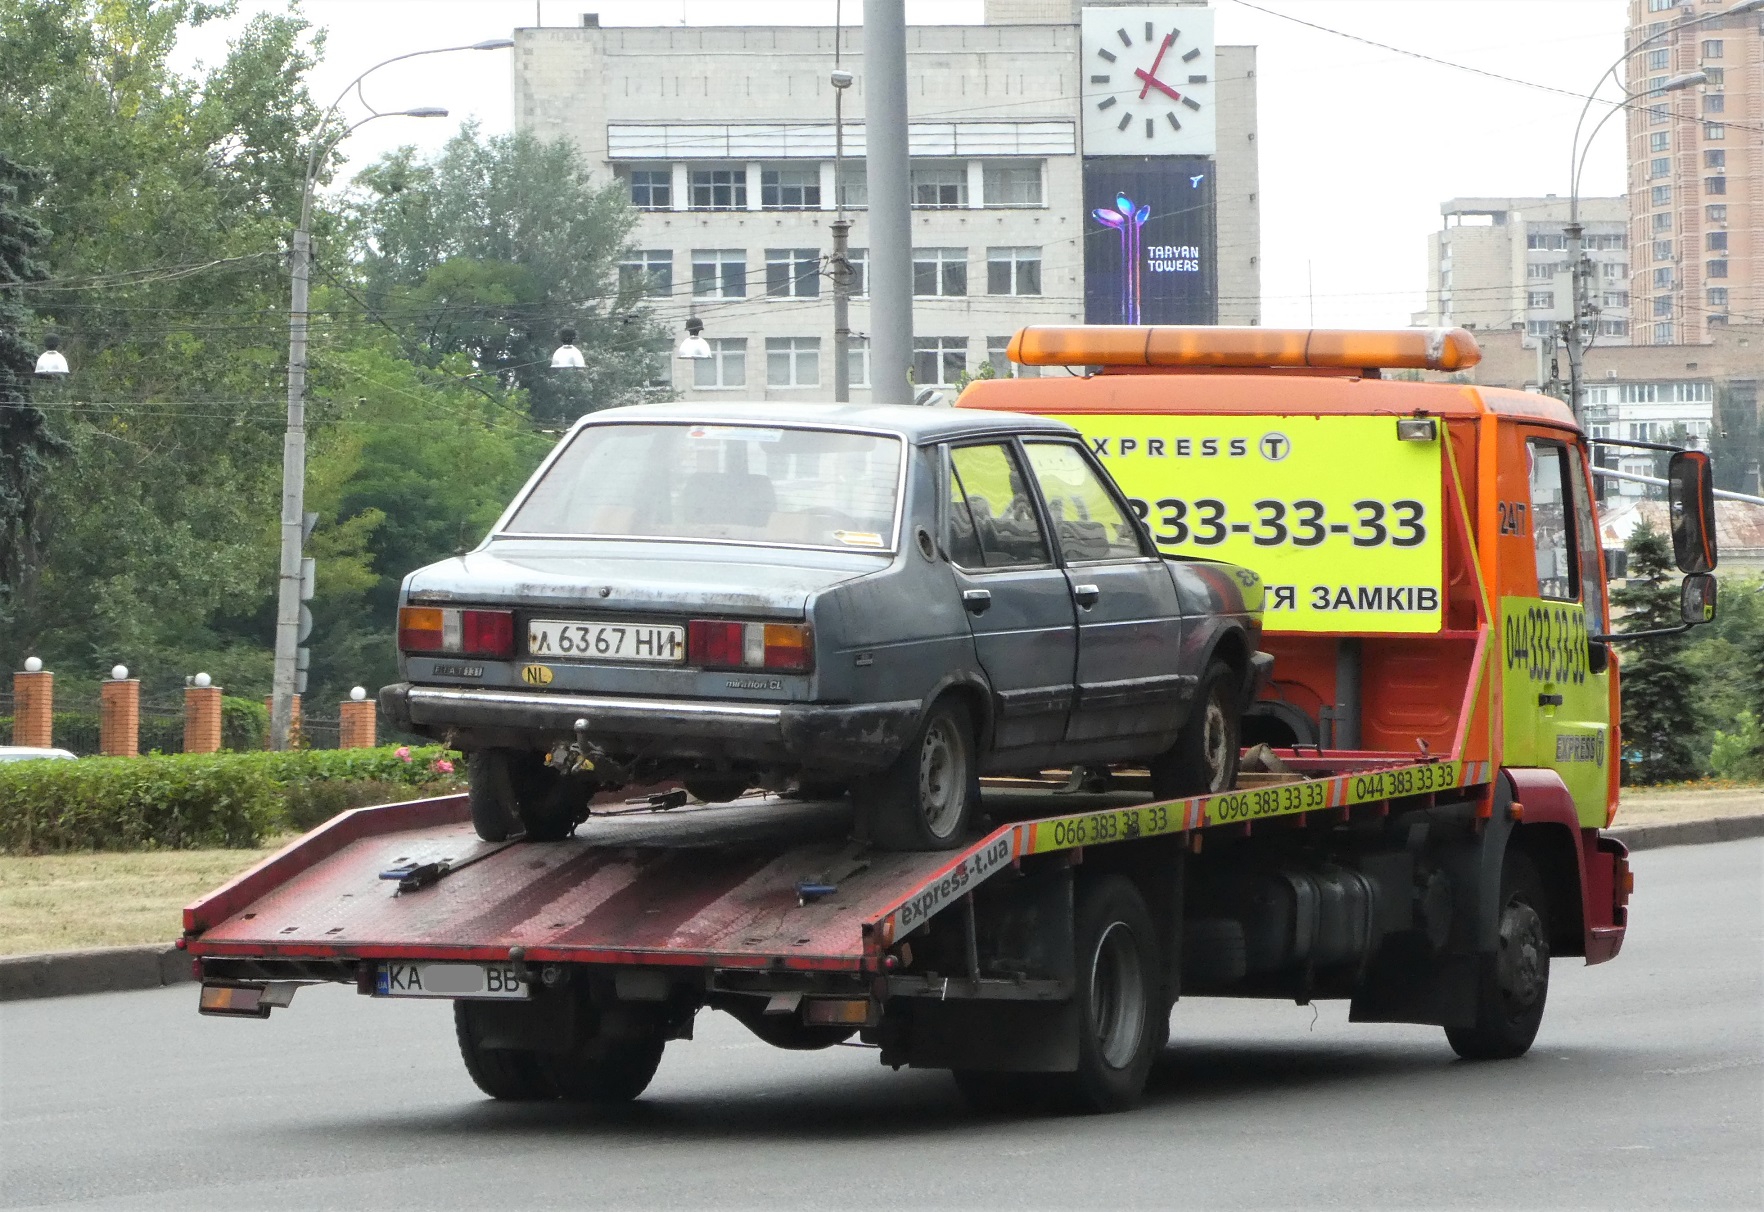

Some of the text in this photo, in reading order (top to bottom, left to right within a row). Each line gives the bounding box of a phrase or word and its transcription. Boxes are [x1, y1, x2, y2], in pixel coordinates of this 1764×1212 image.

[1147, 246, 1199, 258] TARYAN
[1147, 260, 1199, 272] TOWERS
[1311, 586, 1438, 611] ЗАМКІВ
[558, 626, 626, 654] 6367
[527, 667, 548, 684] NL
[1356, 765, 1454, 800] 044 383 33 33
[1218, 784, 1323, 820] 096 383 33 33
[1054, 819, 1086, 846] 066
[1090, 814, 1117, 841] 383
[1148, 807, 1168, 831] 33
